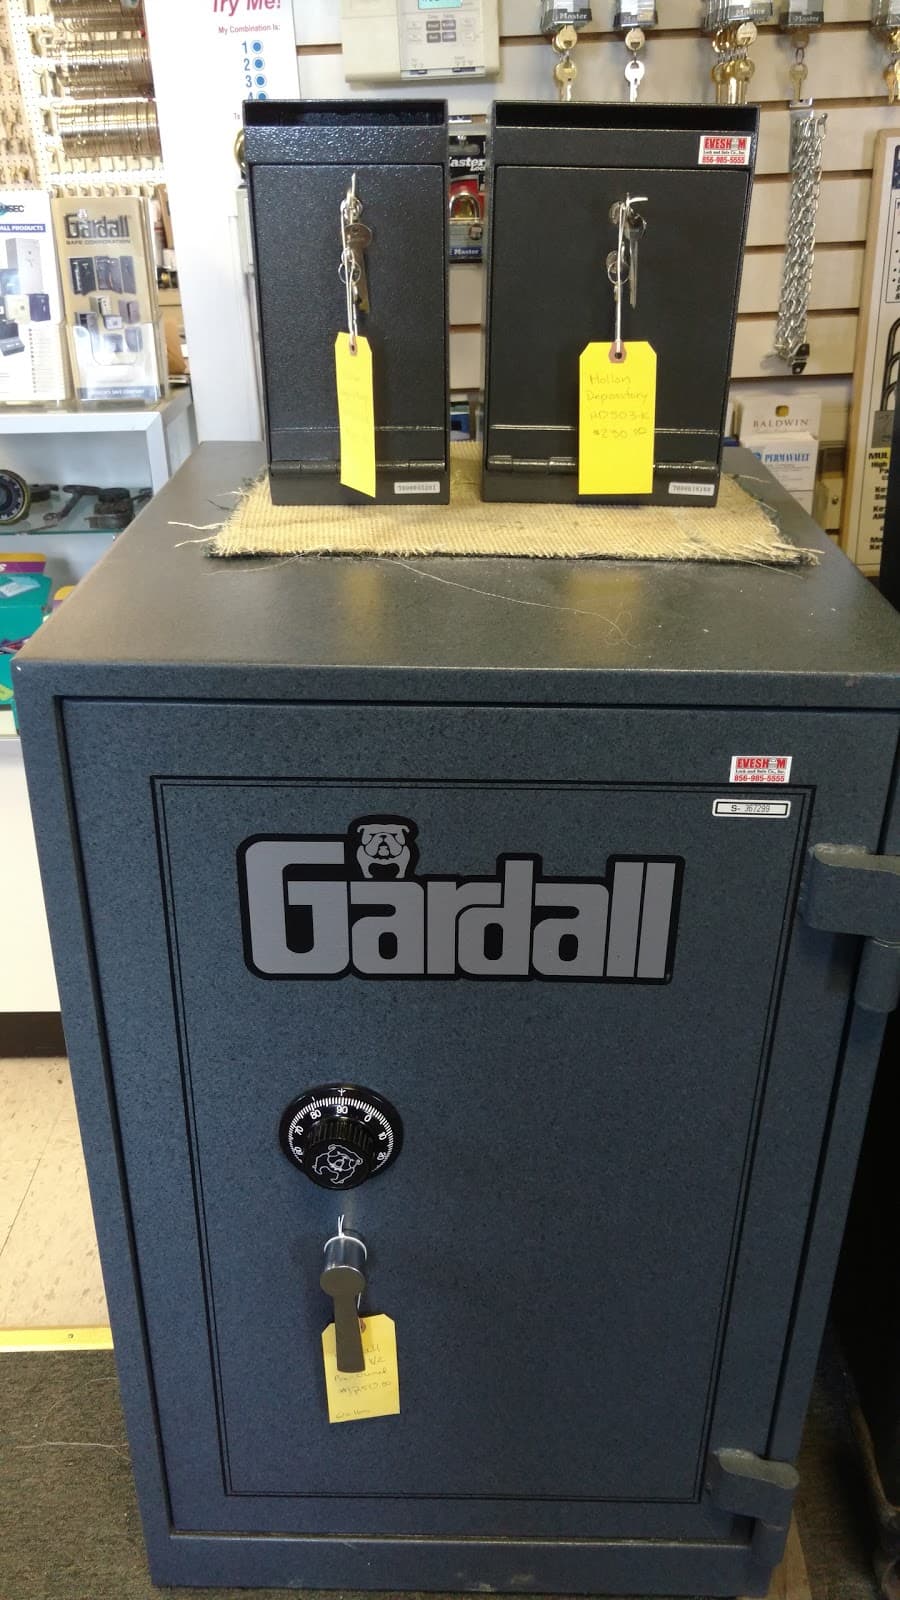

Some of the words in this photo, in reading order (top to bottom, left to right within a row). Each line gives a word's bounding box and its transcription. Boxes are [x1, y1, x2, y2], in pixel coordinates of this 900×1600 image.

[213, 0, 239, 16] Try
[246, 0, 281, 10] Me!
[218, 26, 228, 35] My
[229, 24, 271, 33] Combination
[241, 41, 248, 54] 1
[243, 58, 250, 71] 2
[245, 75, 252, 88] 3
[449, 157, 486, 168] aster
[65, 213, 130, 238] Gardall
[753, 418, 809, 429] BALDWIN
[241, 833, 681, 981] Gardall
[336, 1105, 348, 1114] 90
